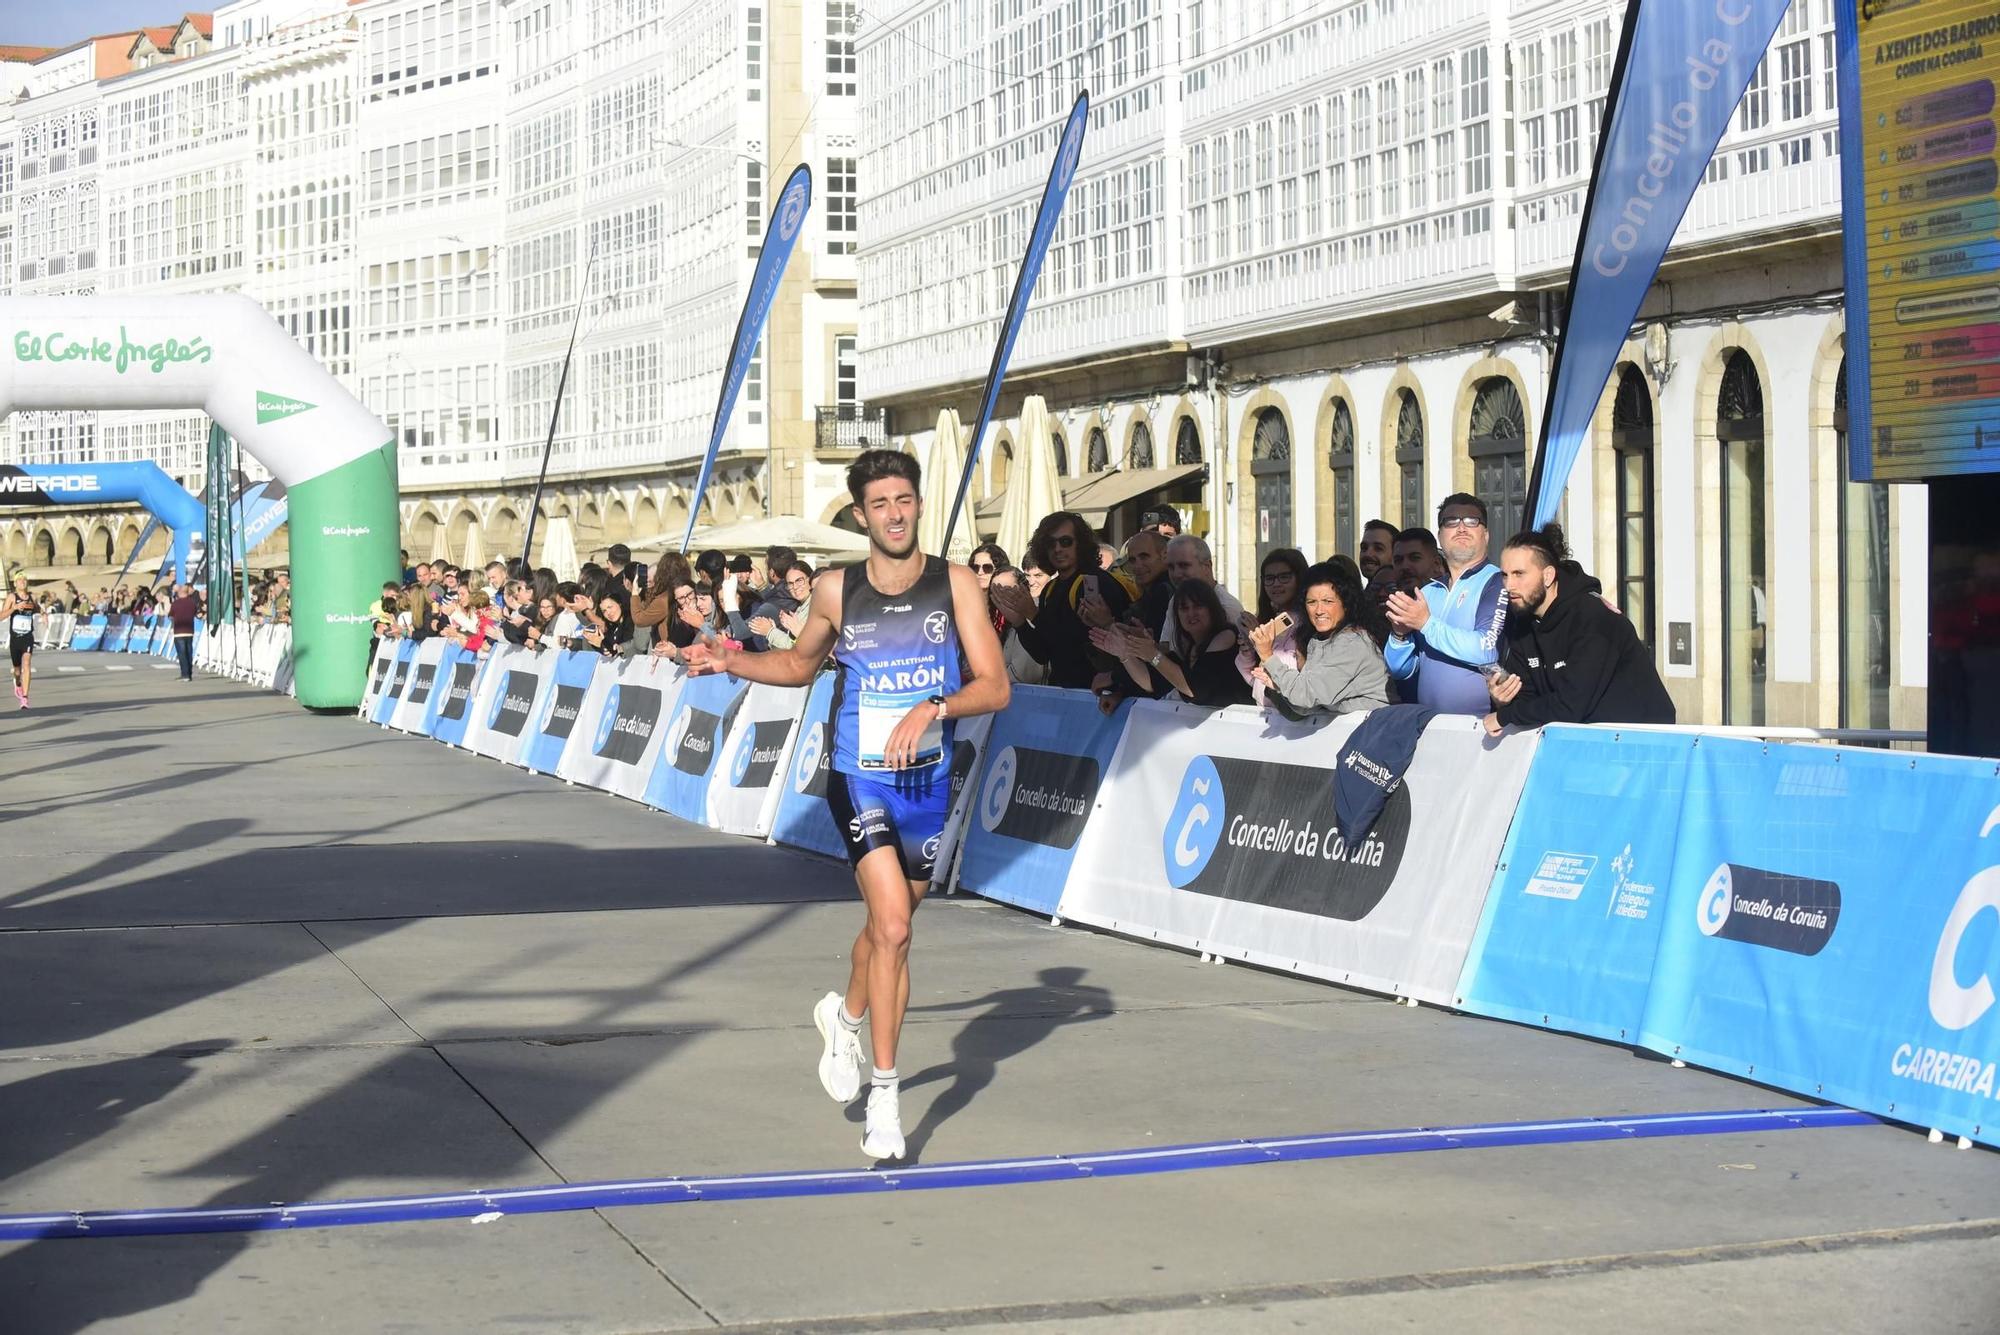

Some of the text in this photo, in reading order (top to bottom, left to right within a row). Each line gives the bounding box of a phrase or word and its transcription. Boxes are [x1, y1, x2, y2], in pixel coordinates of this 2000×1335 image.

[1875, 45, 1884, 64] A
[1886, 34, 1922, 61] XENTE
[1923, 27, 1949, 52] DOS
[1926, 55, 1941, 73] NA
[1942, 42, 1983, 67] CORUÑA
[1593, 101, 1698, 277] Concello
[1685, 38, 1732, 91] da
[14, 325, 212, 374] El Corte Inglés
[861, 665, 945, 692] NARÓN
[868, 655, 935, 670] CLUB ATLETISMO
[820, 752, 831, 770] Co
[950, 770, 964, 791] ña
[1015, 783, 1048, 809] Concello
[1049, 785, 1061, 811] da
[1228, 814, 1293, 853] Concello
[1294, 821, 1319, 858] da
[1733, 894, 1773, 918] Concello
[1773, 902, 1787, 922] da
[1789, 905, 1828, 930] Coruña
[1891, 1042, 1996, 1099] CARREIRA
